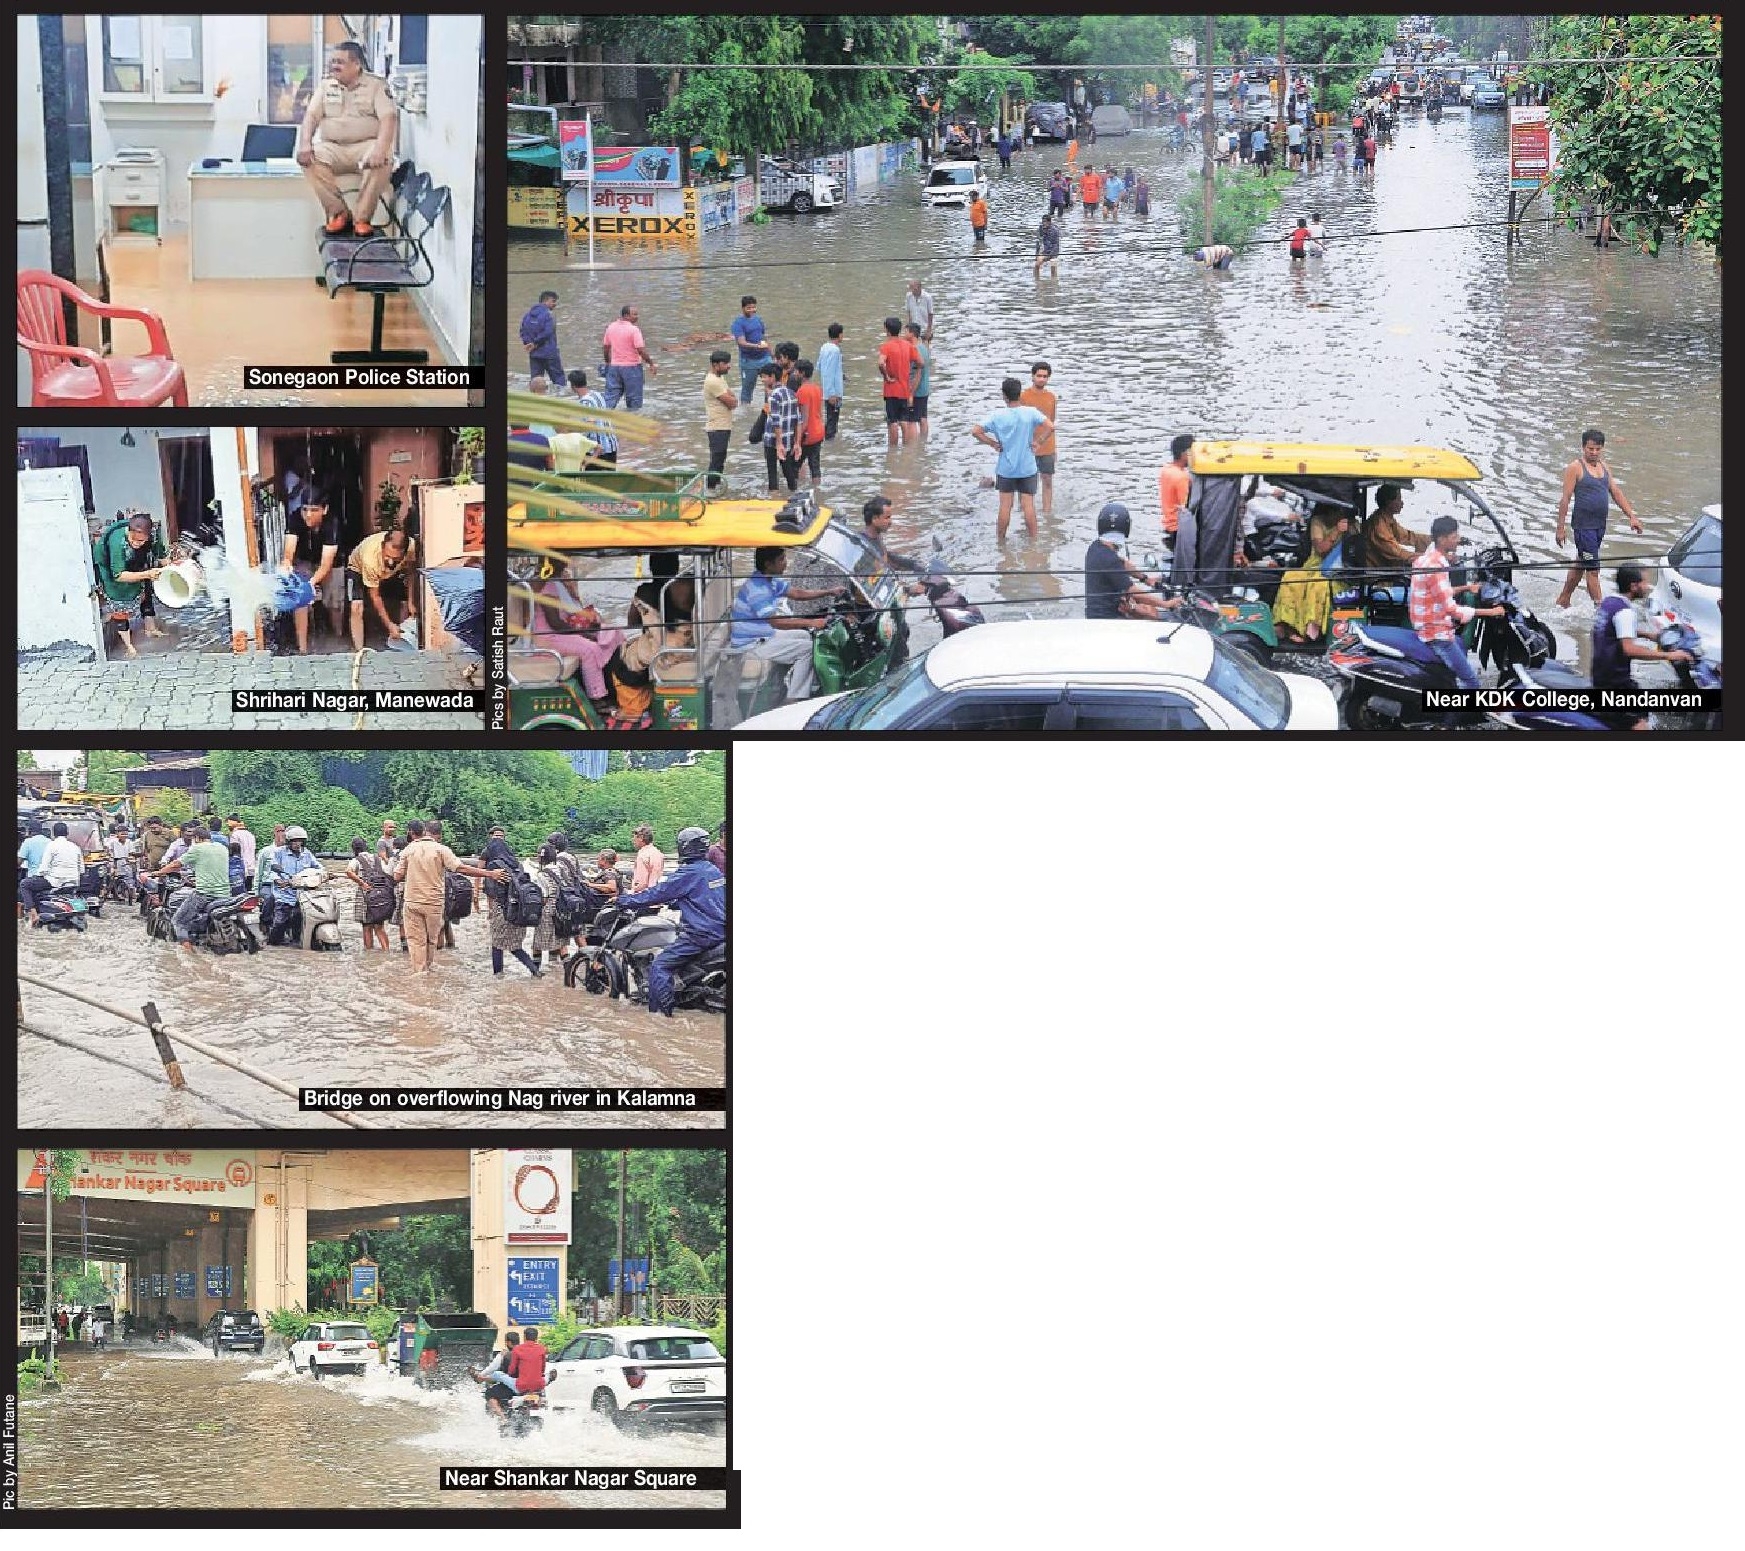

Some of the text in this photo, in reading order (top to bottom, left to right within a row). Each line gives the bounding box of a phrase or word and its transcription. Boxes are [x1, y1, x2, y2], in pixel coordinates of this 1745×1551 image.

[593, 188, 655, 215] श्रीकृपा
[571, 216, 684, 234] XEROX
[127, 1151, 158, 1166] नगर
[69, 1174, 226, 1194] ankar Nagar Square
[523, 1260, 557, 1270] ENTRY
[523, 1272, 546, 1281] EXIT
